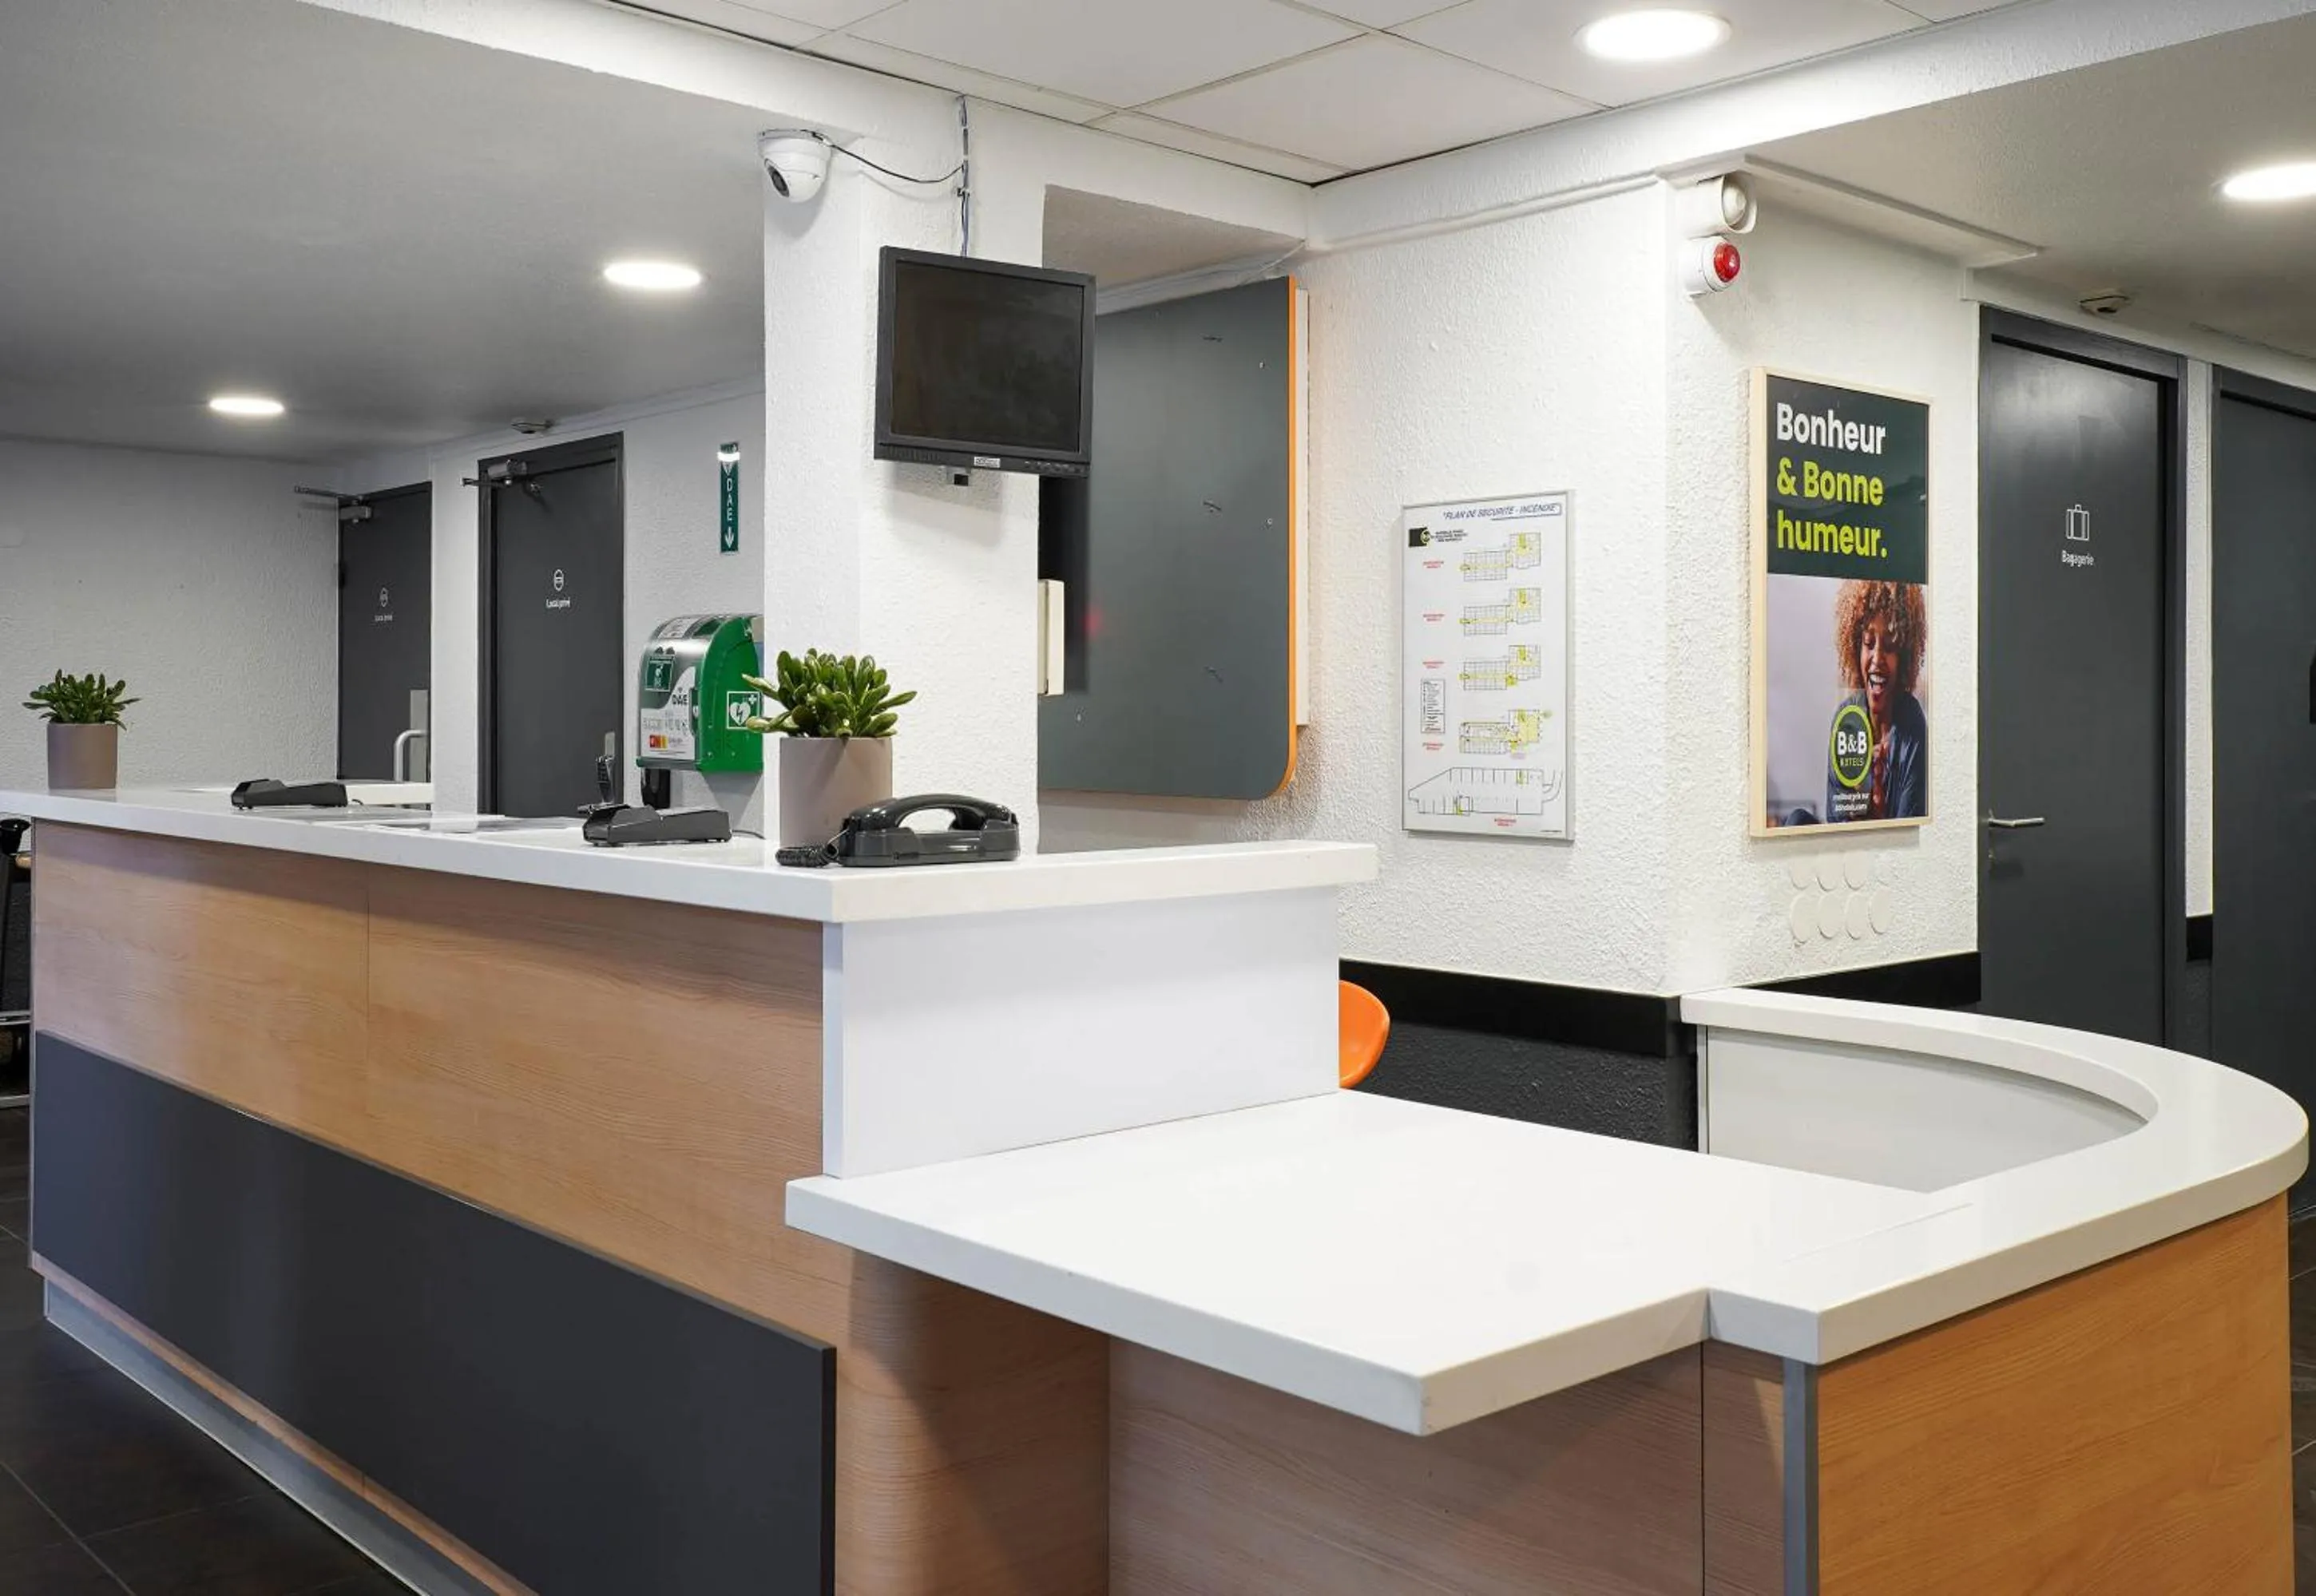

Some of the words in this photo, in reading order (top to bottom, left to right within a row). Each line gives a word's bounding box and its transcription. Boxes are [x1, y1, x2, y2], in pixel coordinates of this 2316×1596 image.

[1776, 402, 1886, 454] Bonheur
[1776, 457, 1798, 496] &
[1803, 461, 1884, 506] Bonne
[1777, 509, 1888, 558] humeur.
[1838, 731, 1867, 754] B&B
